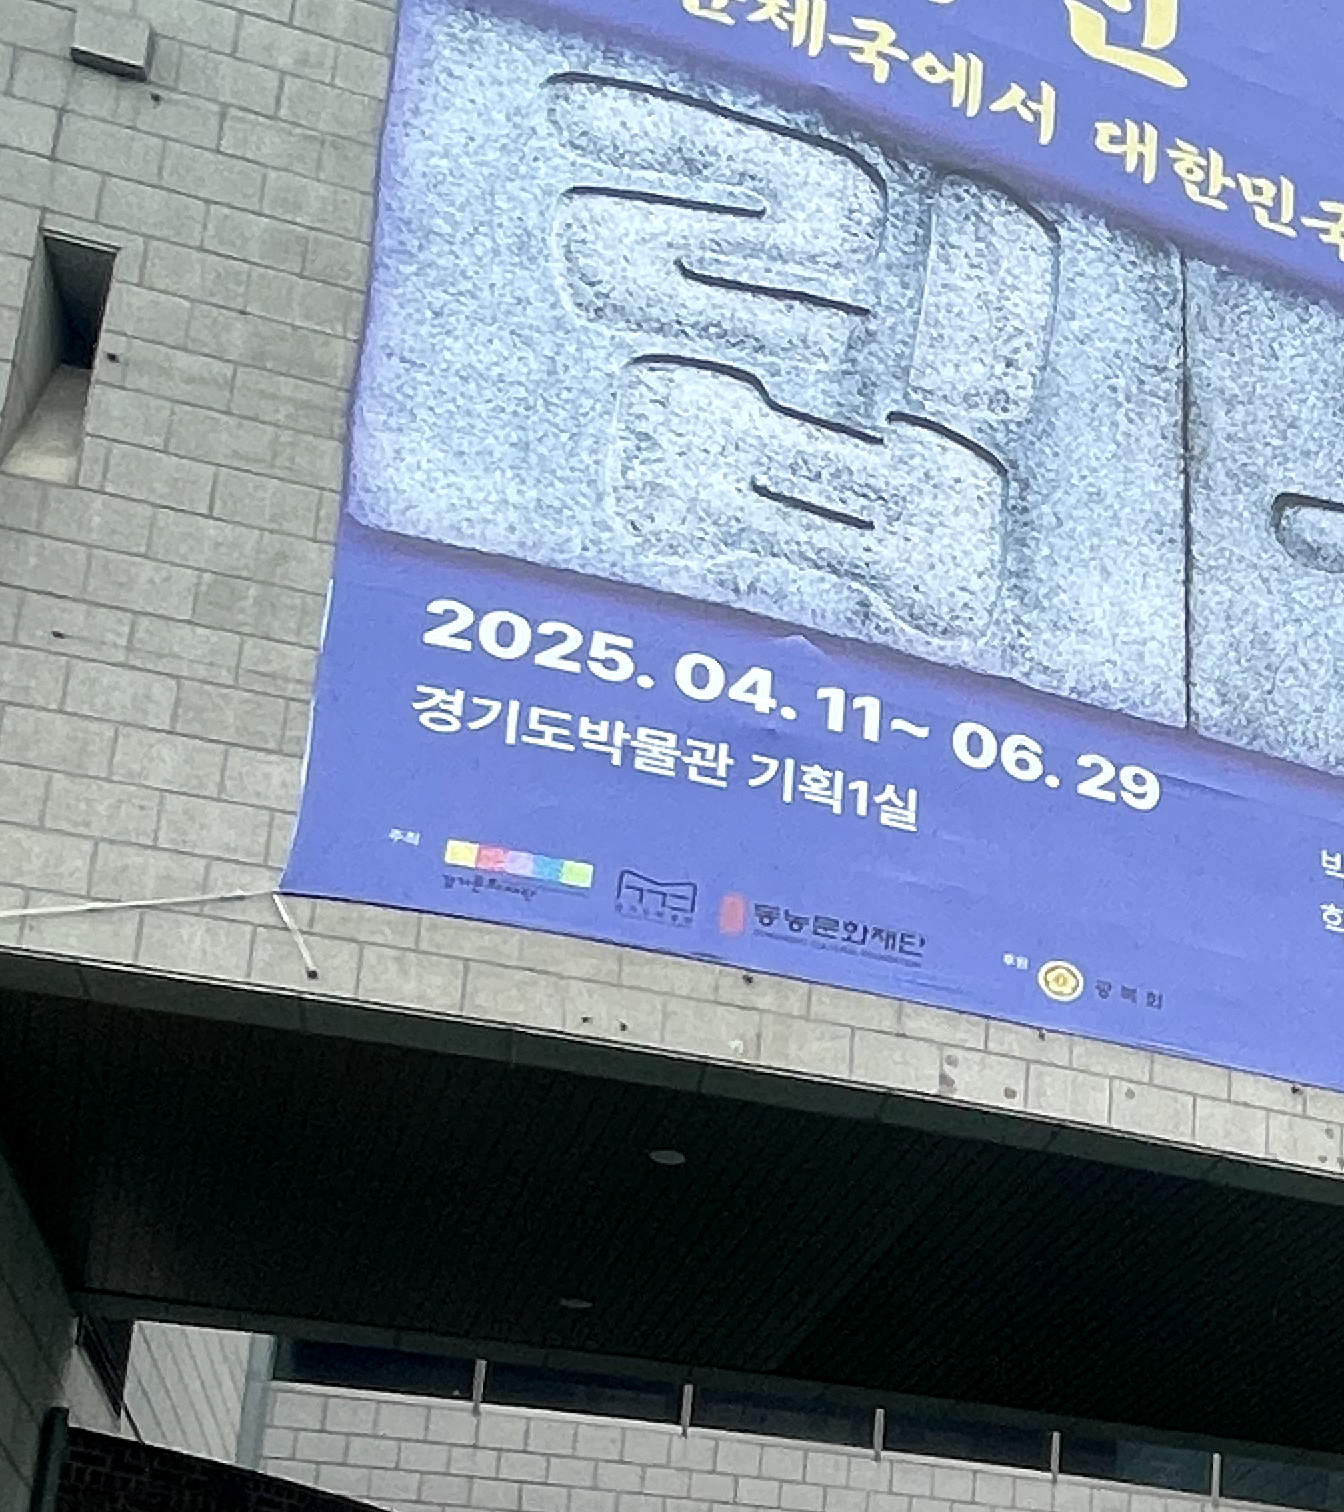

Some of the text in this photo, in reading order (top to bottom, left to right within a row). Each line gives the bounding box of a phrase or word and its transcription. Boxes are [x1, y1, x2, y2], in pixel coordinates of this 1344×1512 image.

[411, 683, 919, 833] 경기도박물관 기획1실
[421, 598, 655, 690] 2025.
[673, 651, 798, 721] 04.
[951, 721, 1061, 789] 06.
[1075, 753, 1161, 811] 29
